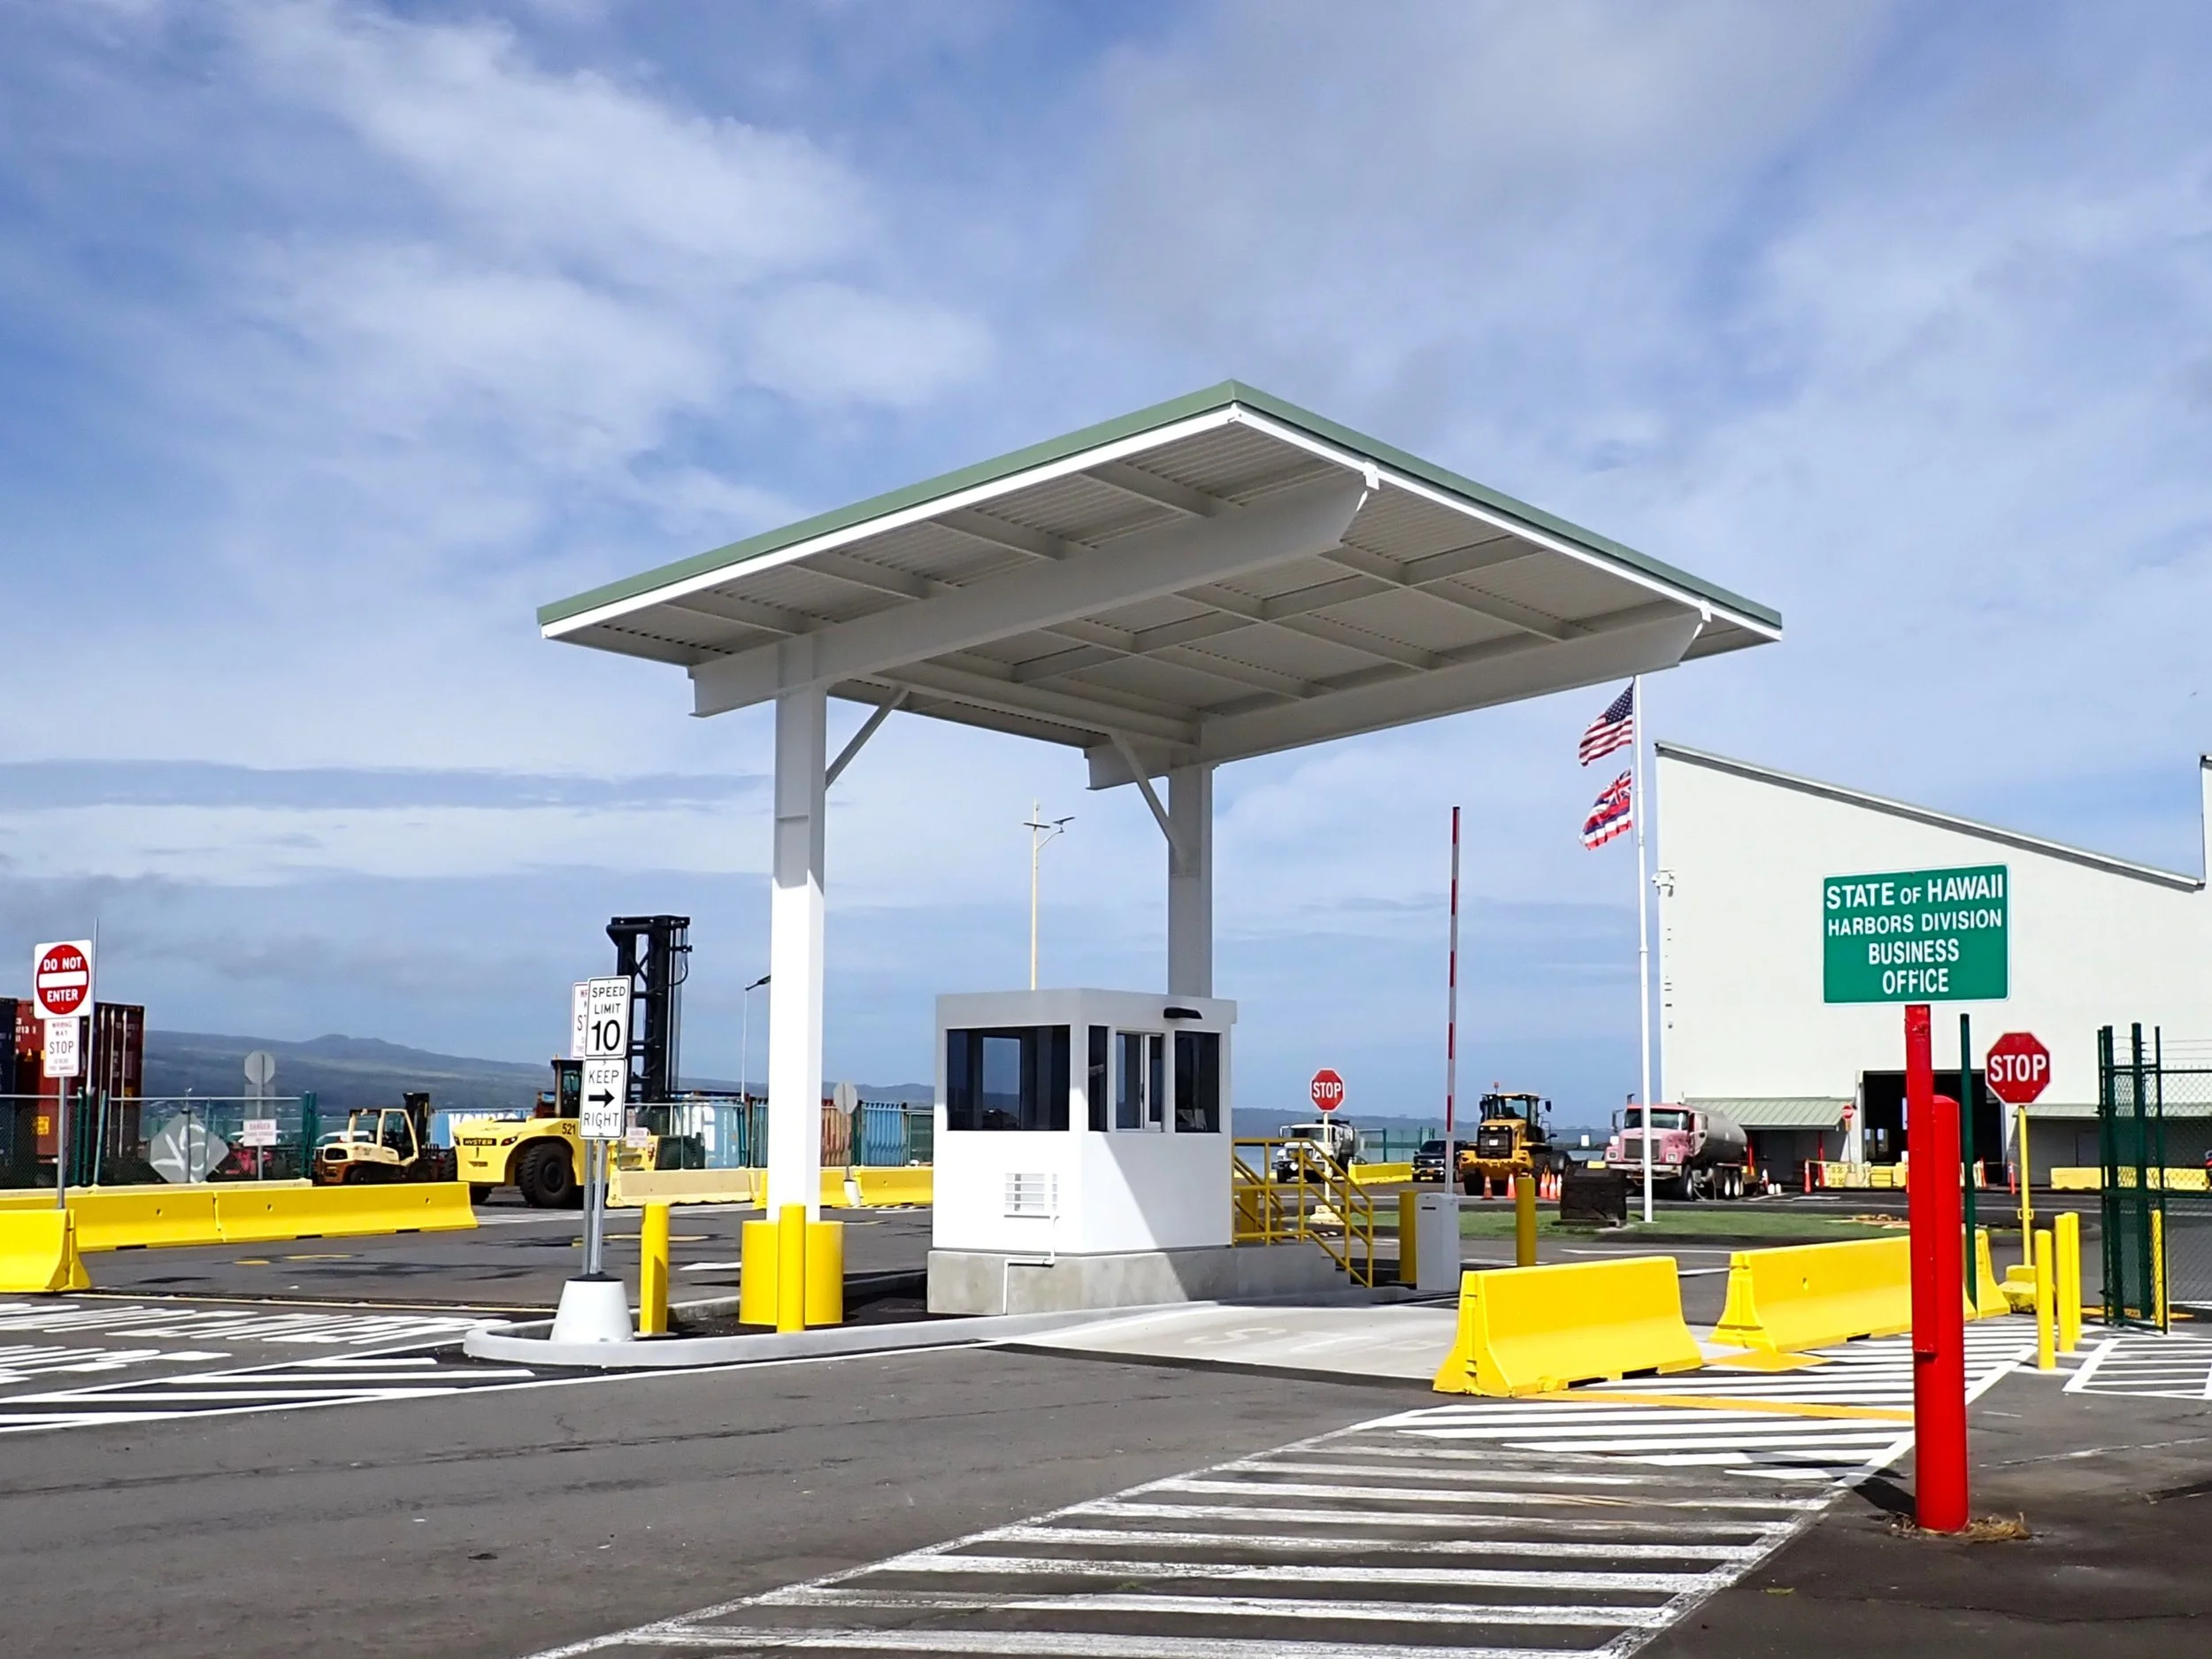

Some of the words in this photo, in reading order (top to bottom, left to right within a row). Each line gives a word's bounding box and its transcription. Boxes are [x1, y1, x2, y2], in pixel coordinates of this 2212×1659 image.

[1826, 882, 1894, 910] STATE
[1901, 887, 1922, 904] OF
[1928, 874, 2003, 902] HAWAII
[1828, 914, 1914, 936] HARBORS
[1922, 909, 2001, 931] DIVISION
[1869, 939, 1959, 964] BUSINESS
[43, 958, 58, 972] DO
[62, 956, 82, 970] NOT
[1883, 968, 1948, 994] OFFICE
[47, 988, 79, 1002] ENTER
[592, 987, 626, 998] SPEED
[595, 1003, 621, 1015] LIMIT
[591, 1019, 620, 1051] 10
[50, 1041, 74, 1055] STOP
[1990, 1054, 2047, 1082] STOP
[588, 1070, 619, 1084] KEEP
[1313, 1082, 1341, 1098] STOP
[583, 1112, 619, 1127] RIGHT
[562, 1122, 576, 1135] 521
